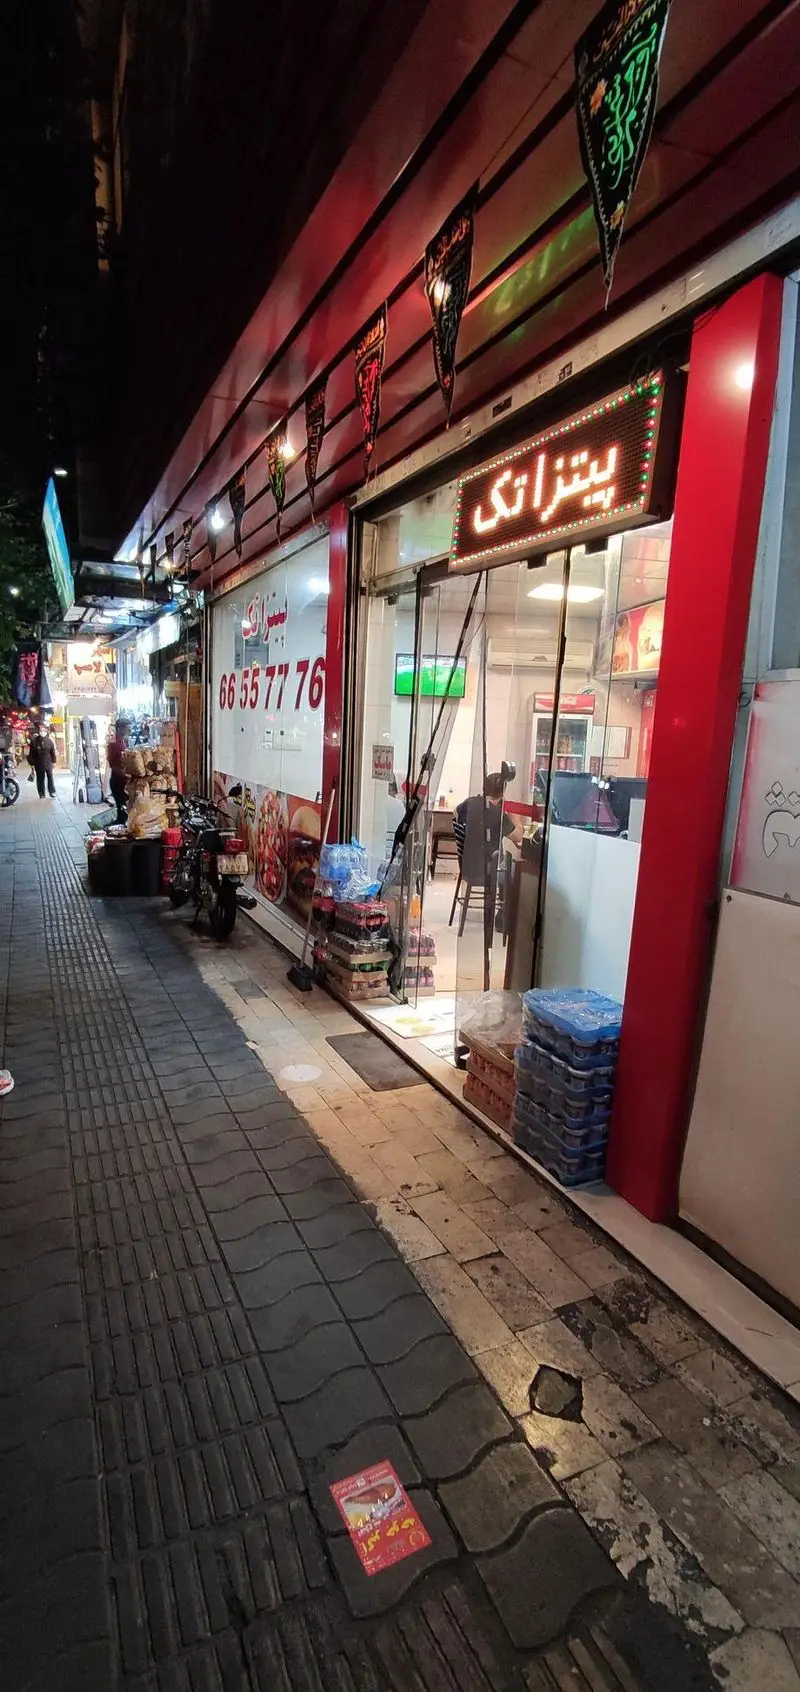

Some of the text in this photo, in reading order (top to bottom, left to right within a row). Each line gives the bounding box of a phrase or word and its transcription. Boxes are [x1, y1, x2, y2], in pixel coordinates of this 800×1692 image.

[219, 656, 326, 712] 66 55 77 76
